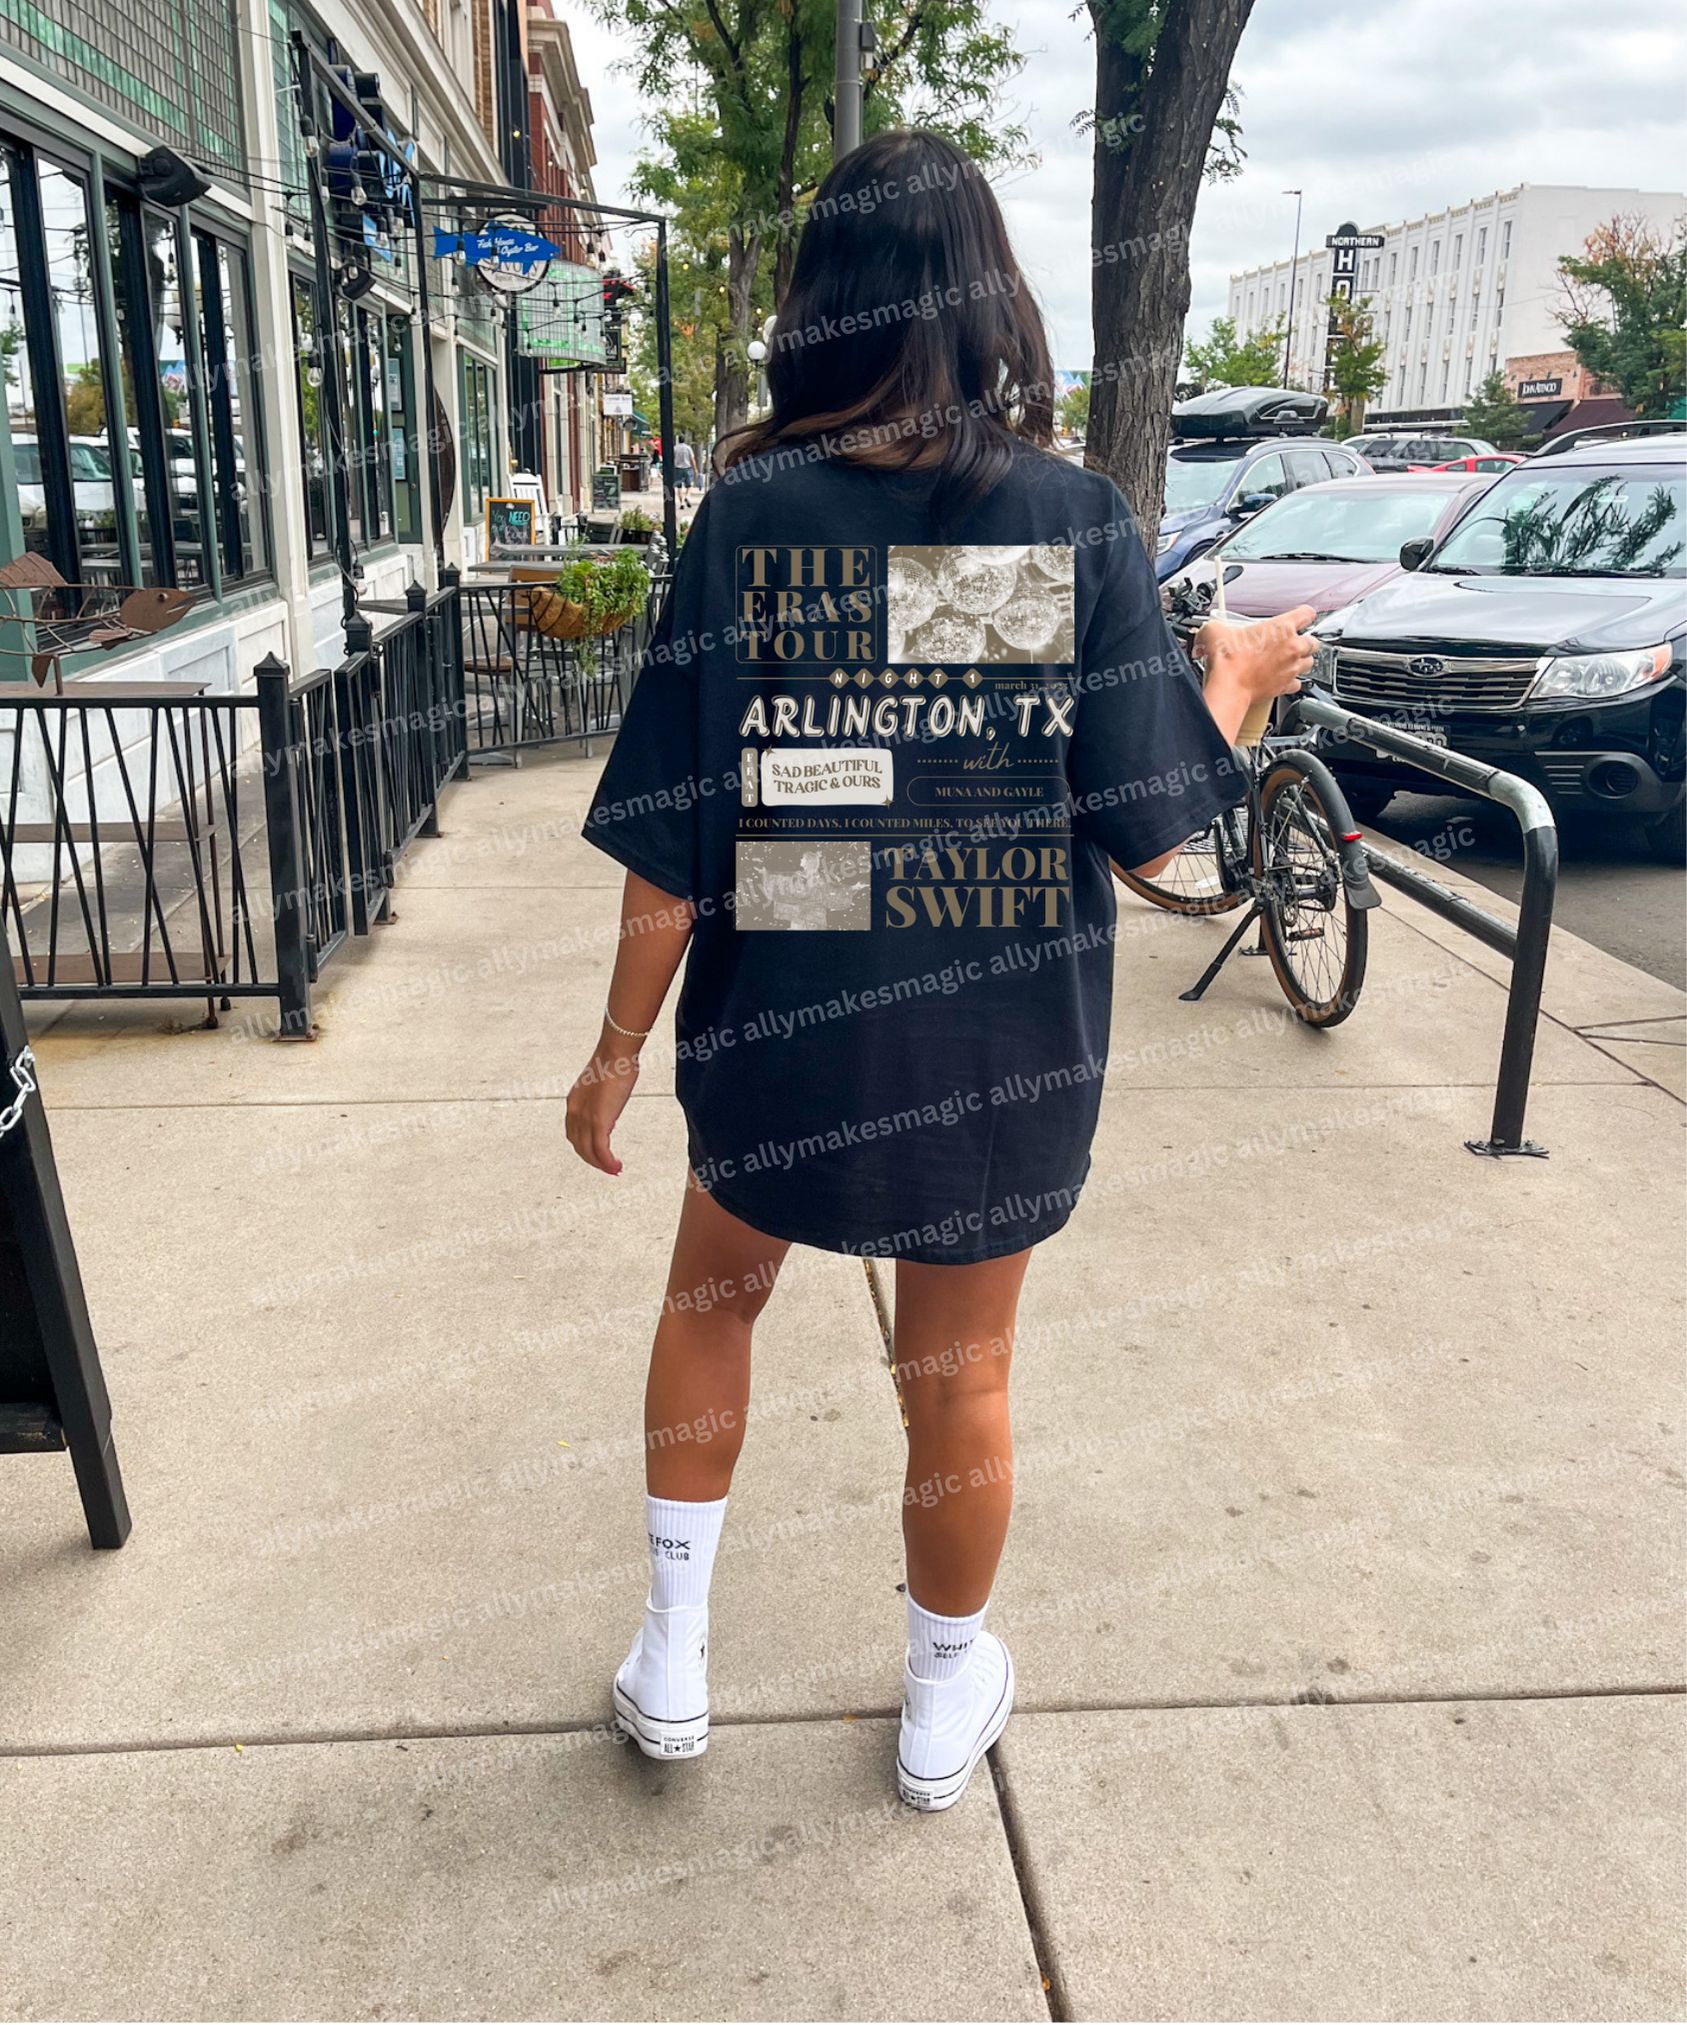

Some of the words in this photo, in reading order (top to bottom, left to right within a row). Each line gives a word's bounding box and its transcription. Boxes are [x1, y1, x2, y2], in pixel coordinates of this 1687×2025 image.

[500, 245, 523, 257] Oyster
[524, 241, 539, 253] Bar
[1331, 237, 1380, 247] NORTHERN
[742, 548, 871, 587] THE
[741, 590, 873, 624] ERAS
[739, 630, 875, 661] TOUR
[834, 672, 942, 684] NIGHT
[969, 672, 976, 684] 1
[994, 681, 1027, 690] march
[739, 694, 996, 741] ARLINGTON,
[1013, 694, 1075, 738] TX
[962, 741, 1015, 771] with
[746, 753, 755, 803] FEAT
[771, 763, 802, 778] SAD
[803, 759, 883, 778] BEAUTIFUL
[773, 779, 828, 794] TRAGIC
[829, 777, 841, 789] &
[842, 775, 882, 789] OURS
[935, 786, 971, 798] MUNA
[972, 786, 1001, 798] AND
[1002, 786, 1044, 798] GAYLE
[745, 817, 805, 829] COUNTED
[851, 817, 911, 829] COUNTED
[955, 817, 974, 829] TO
[884, 846, 1070, 881] TAYLOR
[885, 885, 1071, 929] SWIFT
[664, 1550, 690, 1561] CLUB
